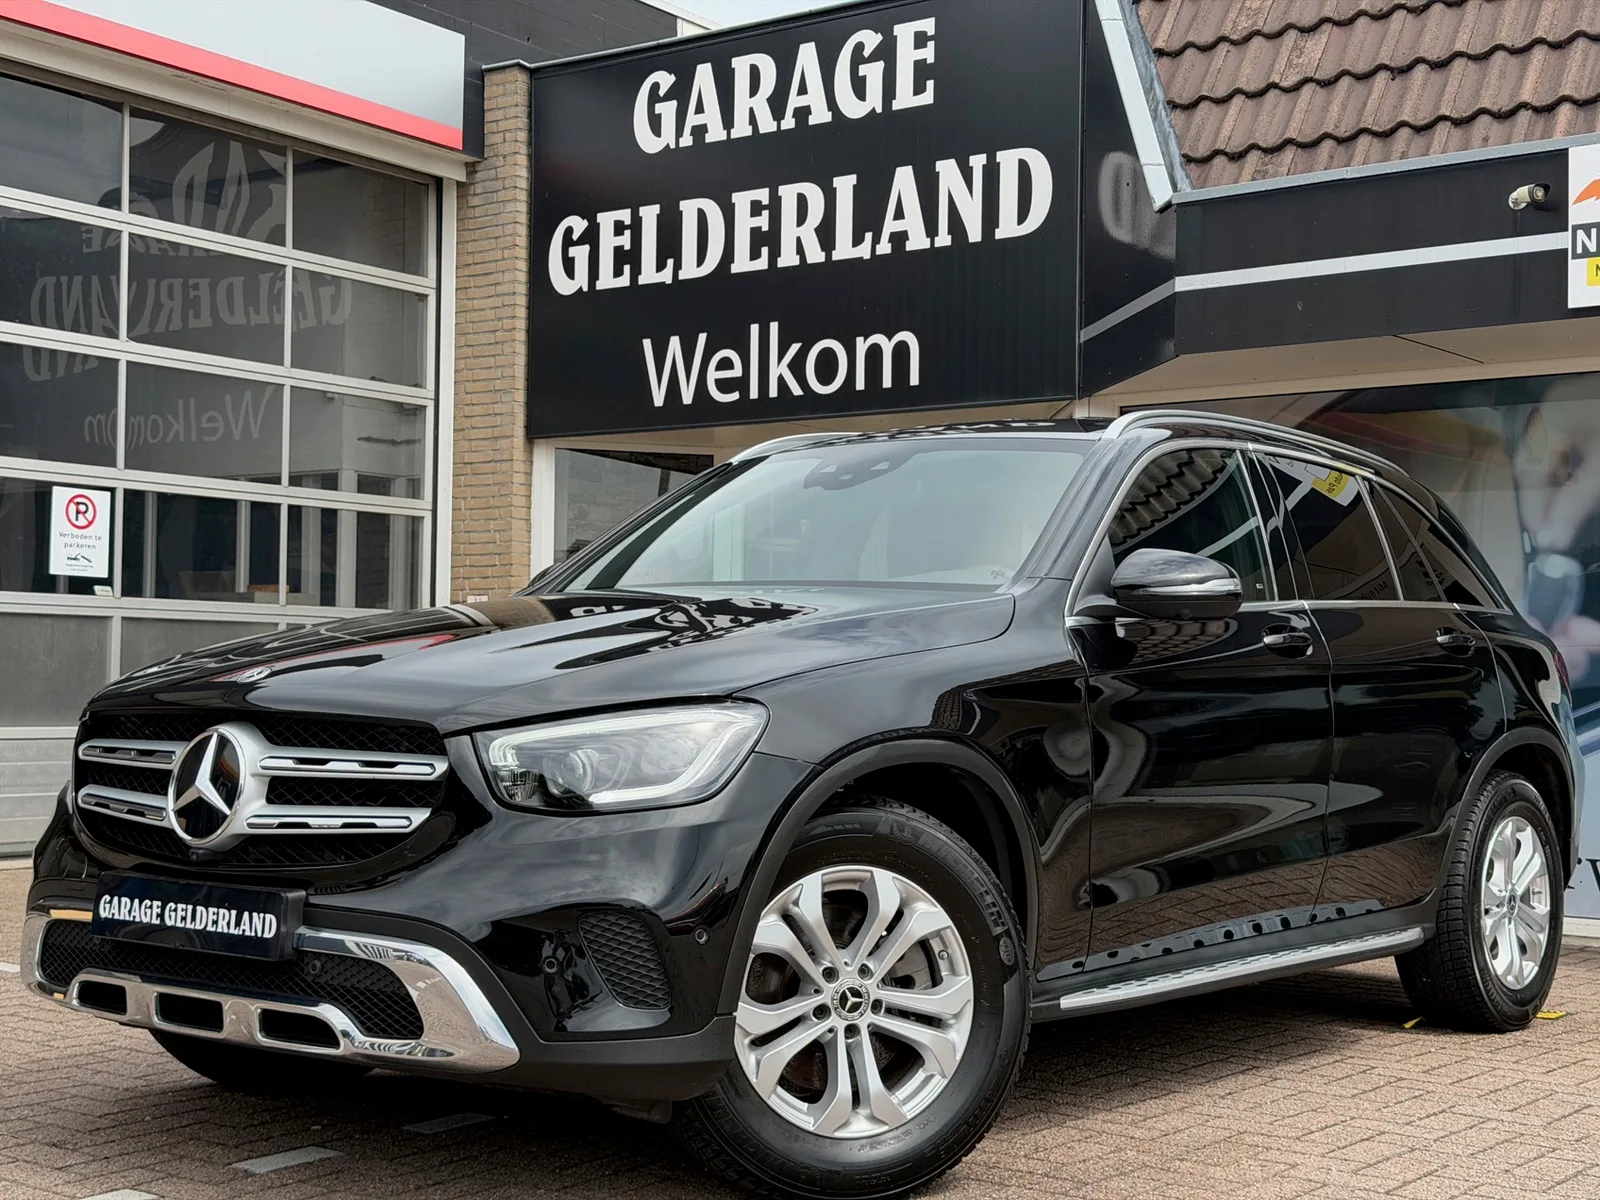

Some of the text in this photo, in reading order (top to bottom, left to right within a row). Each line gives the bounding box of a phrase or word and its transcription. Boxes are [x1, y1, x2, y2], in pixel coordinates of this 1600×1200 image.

[633, 17, 936, 154] GARAGE
[548, 147, 1053, 296] GELDERLAND
[642, 320, 920, 408] Welkom
[58, 531, 93, 541] Verboden
[63, 541, 96, 550] parkeren
[100, 894, 277, 938] GARAGE GELDERLAND
